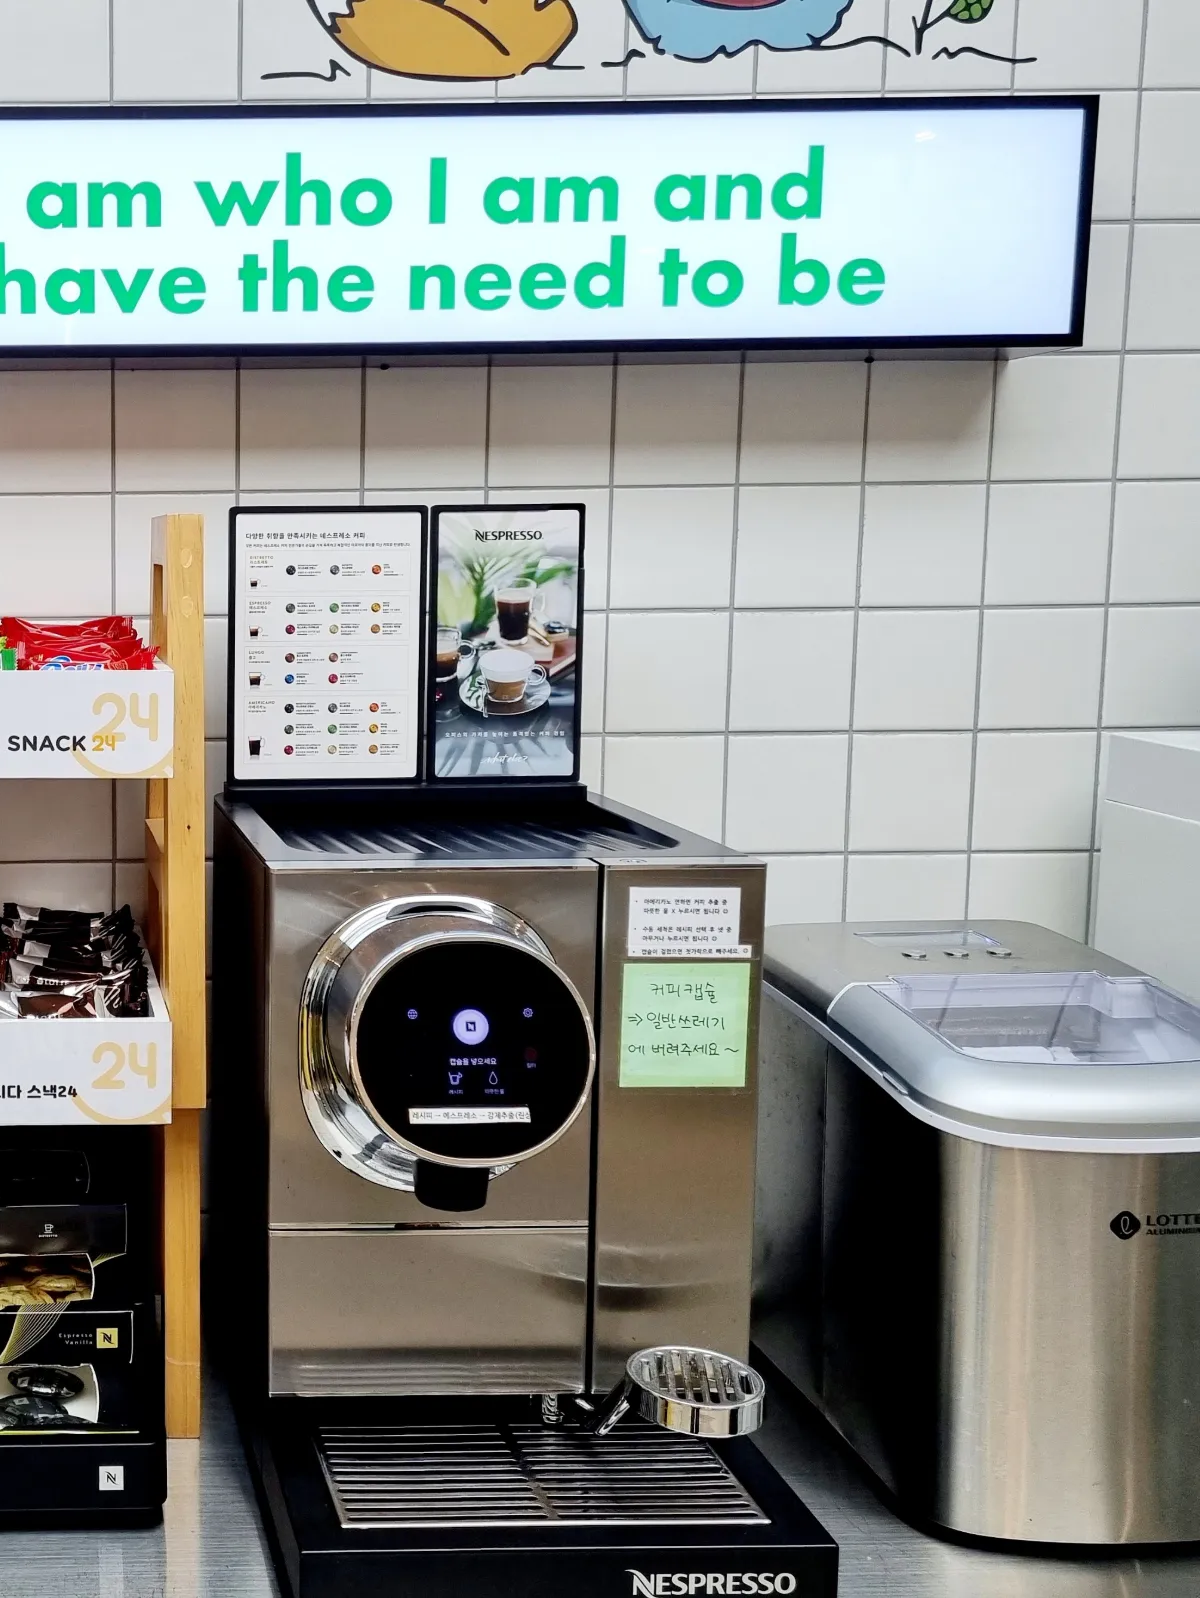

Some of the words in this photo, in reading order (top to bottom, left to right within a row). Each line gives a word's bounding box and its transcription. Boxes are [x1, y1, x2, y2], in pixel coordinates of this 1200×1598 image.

[27, 181, 162, 229] am
[196, 151, 393, 228] who
[429, 157, 447, 224] I
[483, 176, 619, 224] am
[655, 145, 825, 223] and
[238, 239, 374, 313] the
[409, 234, 627, 311] need
[659, 248, 744, 307] to
[779, 232, 885, 305] be
[353, 531, 366, 539] 커피
[473, 529, 543, 543] NESPRESSO
[92, 692, 160, 742] 24
[7, 734, 87, 752] SNACK
[91, 735, 117, 752] 24
[91, 1041, 158, 1091] 24
[27, 1083, 78, 1099] 스낵24
[412, 1111, 433, 1119] 레시피
[624, 1568, 797, 1598] NESPRESSO
